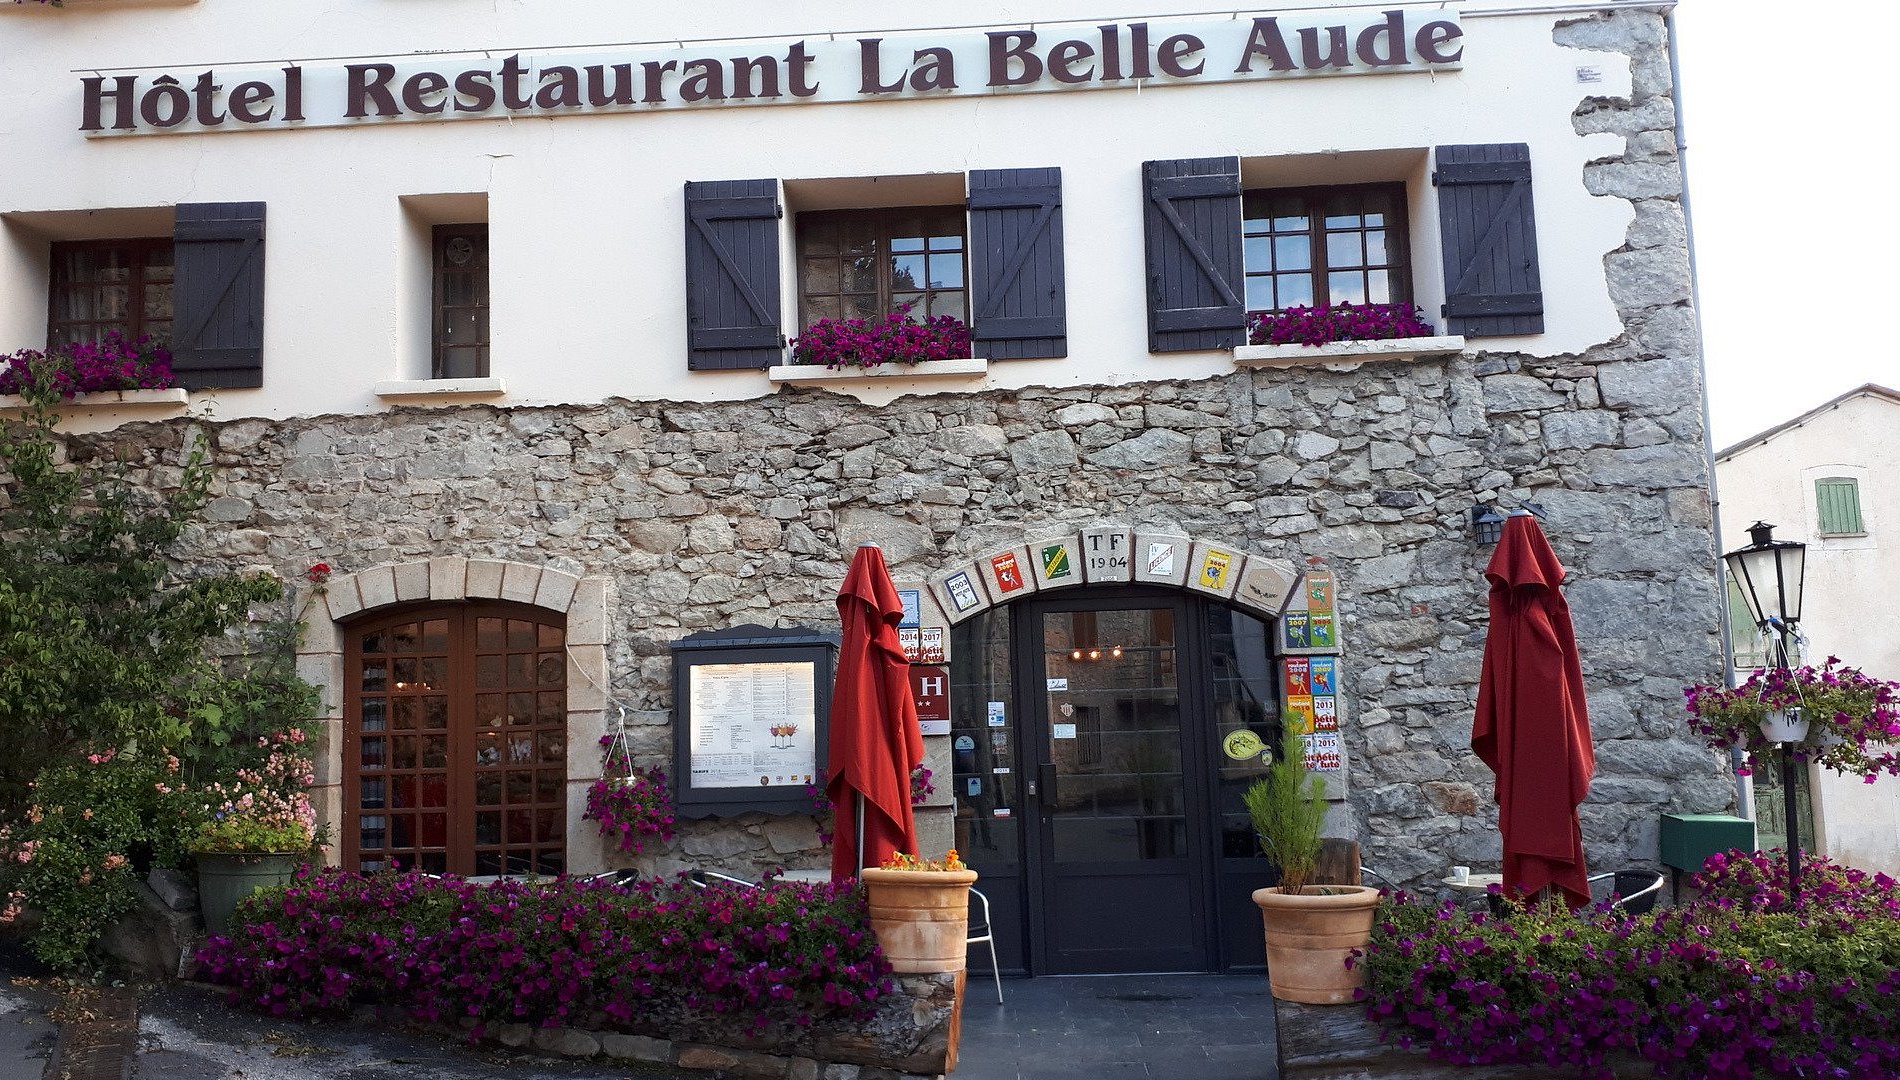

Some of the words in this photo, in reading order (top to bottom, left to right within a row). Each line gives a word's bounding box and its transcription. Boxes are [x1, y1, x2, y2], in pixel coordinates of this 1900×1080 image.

[78, 66, 306, 131] Hôtel
[343, 40, 820, 118] Restaurant
[857, 38, 956, 94] La
[985, 22, 1206, 89] Belle
[1233, 10, 1465, 74] Aude
[1088, 534, 1103, 551] T
[1110, 533, 1124, 551] F
[1091, 556, 1128, 569] 1904
[950, 579, 968, 591] 2003
[900, 633, 918, 641] 2014
[923, 633, 941, 641] 2017
[920, 676, 944, 696] H
[1315, 701, 1333, 709] 2013
[1318, 739, 1336, 747] 2015
